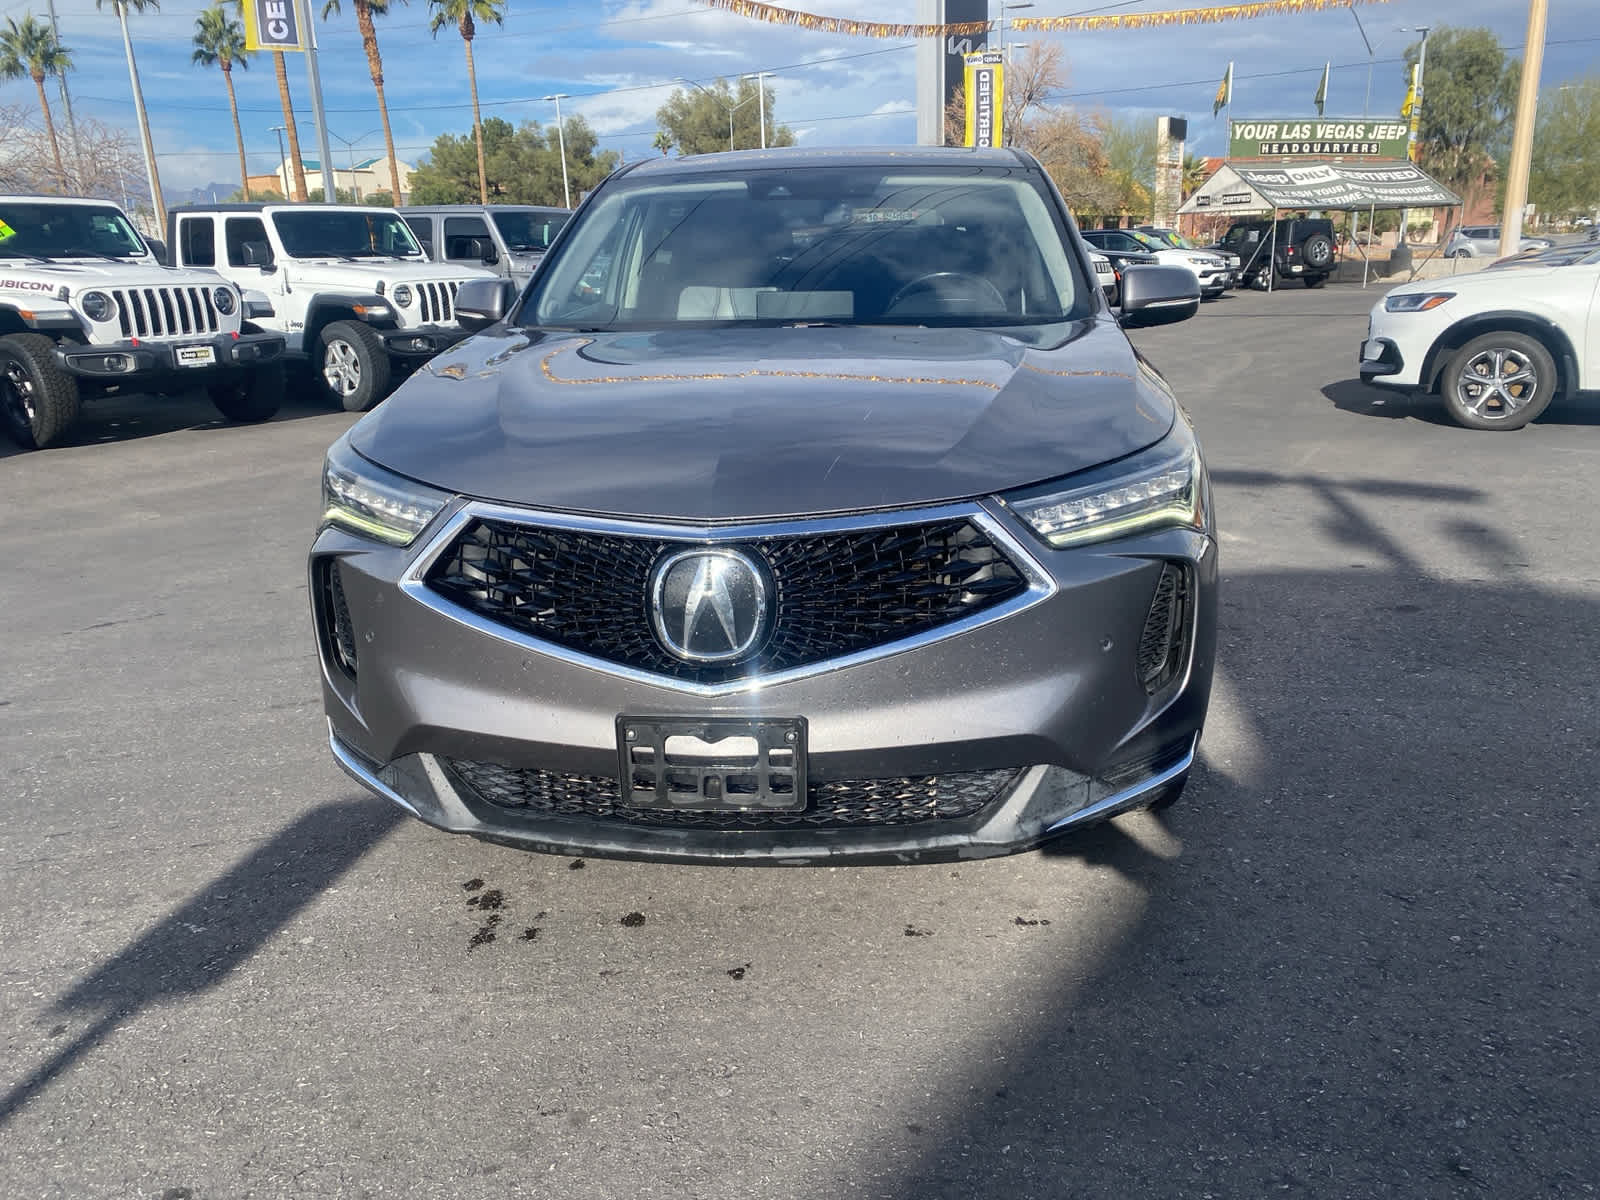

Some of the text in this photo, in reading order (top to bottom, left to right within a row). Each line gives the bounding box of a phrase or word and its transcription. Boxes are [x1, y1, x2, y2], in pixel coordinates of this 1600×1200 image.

[1234, 124, 1407, 140] YOUR LAS VEGAS JEEP
[1261, 143, 1378, 154] HEADQUARTERS
[1247, 171, 1289, 184] Jeep
[1292, 168, 1331, 181] ONLY
[1314, 185, 1346, 196] YOUR
